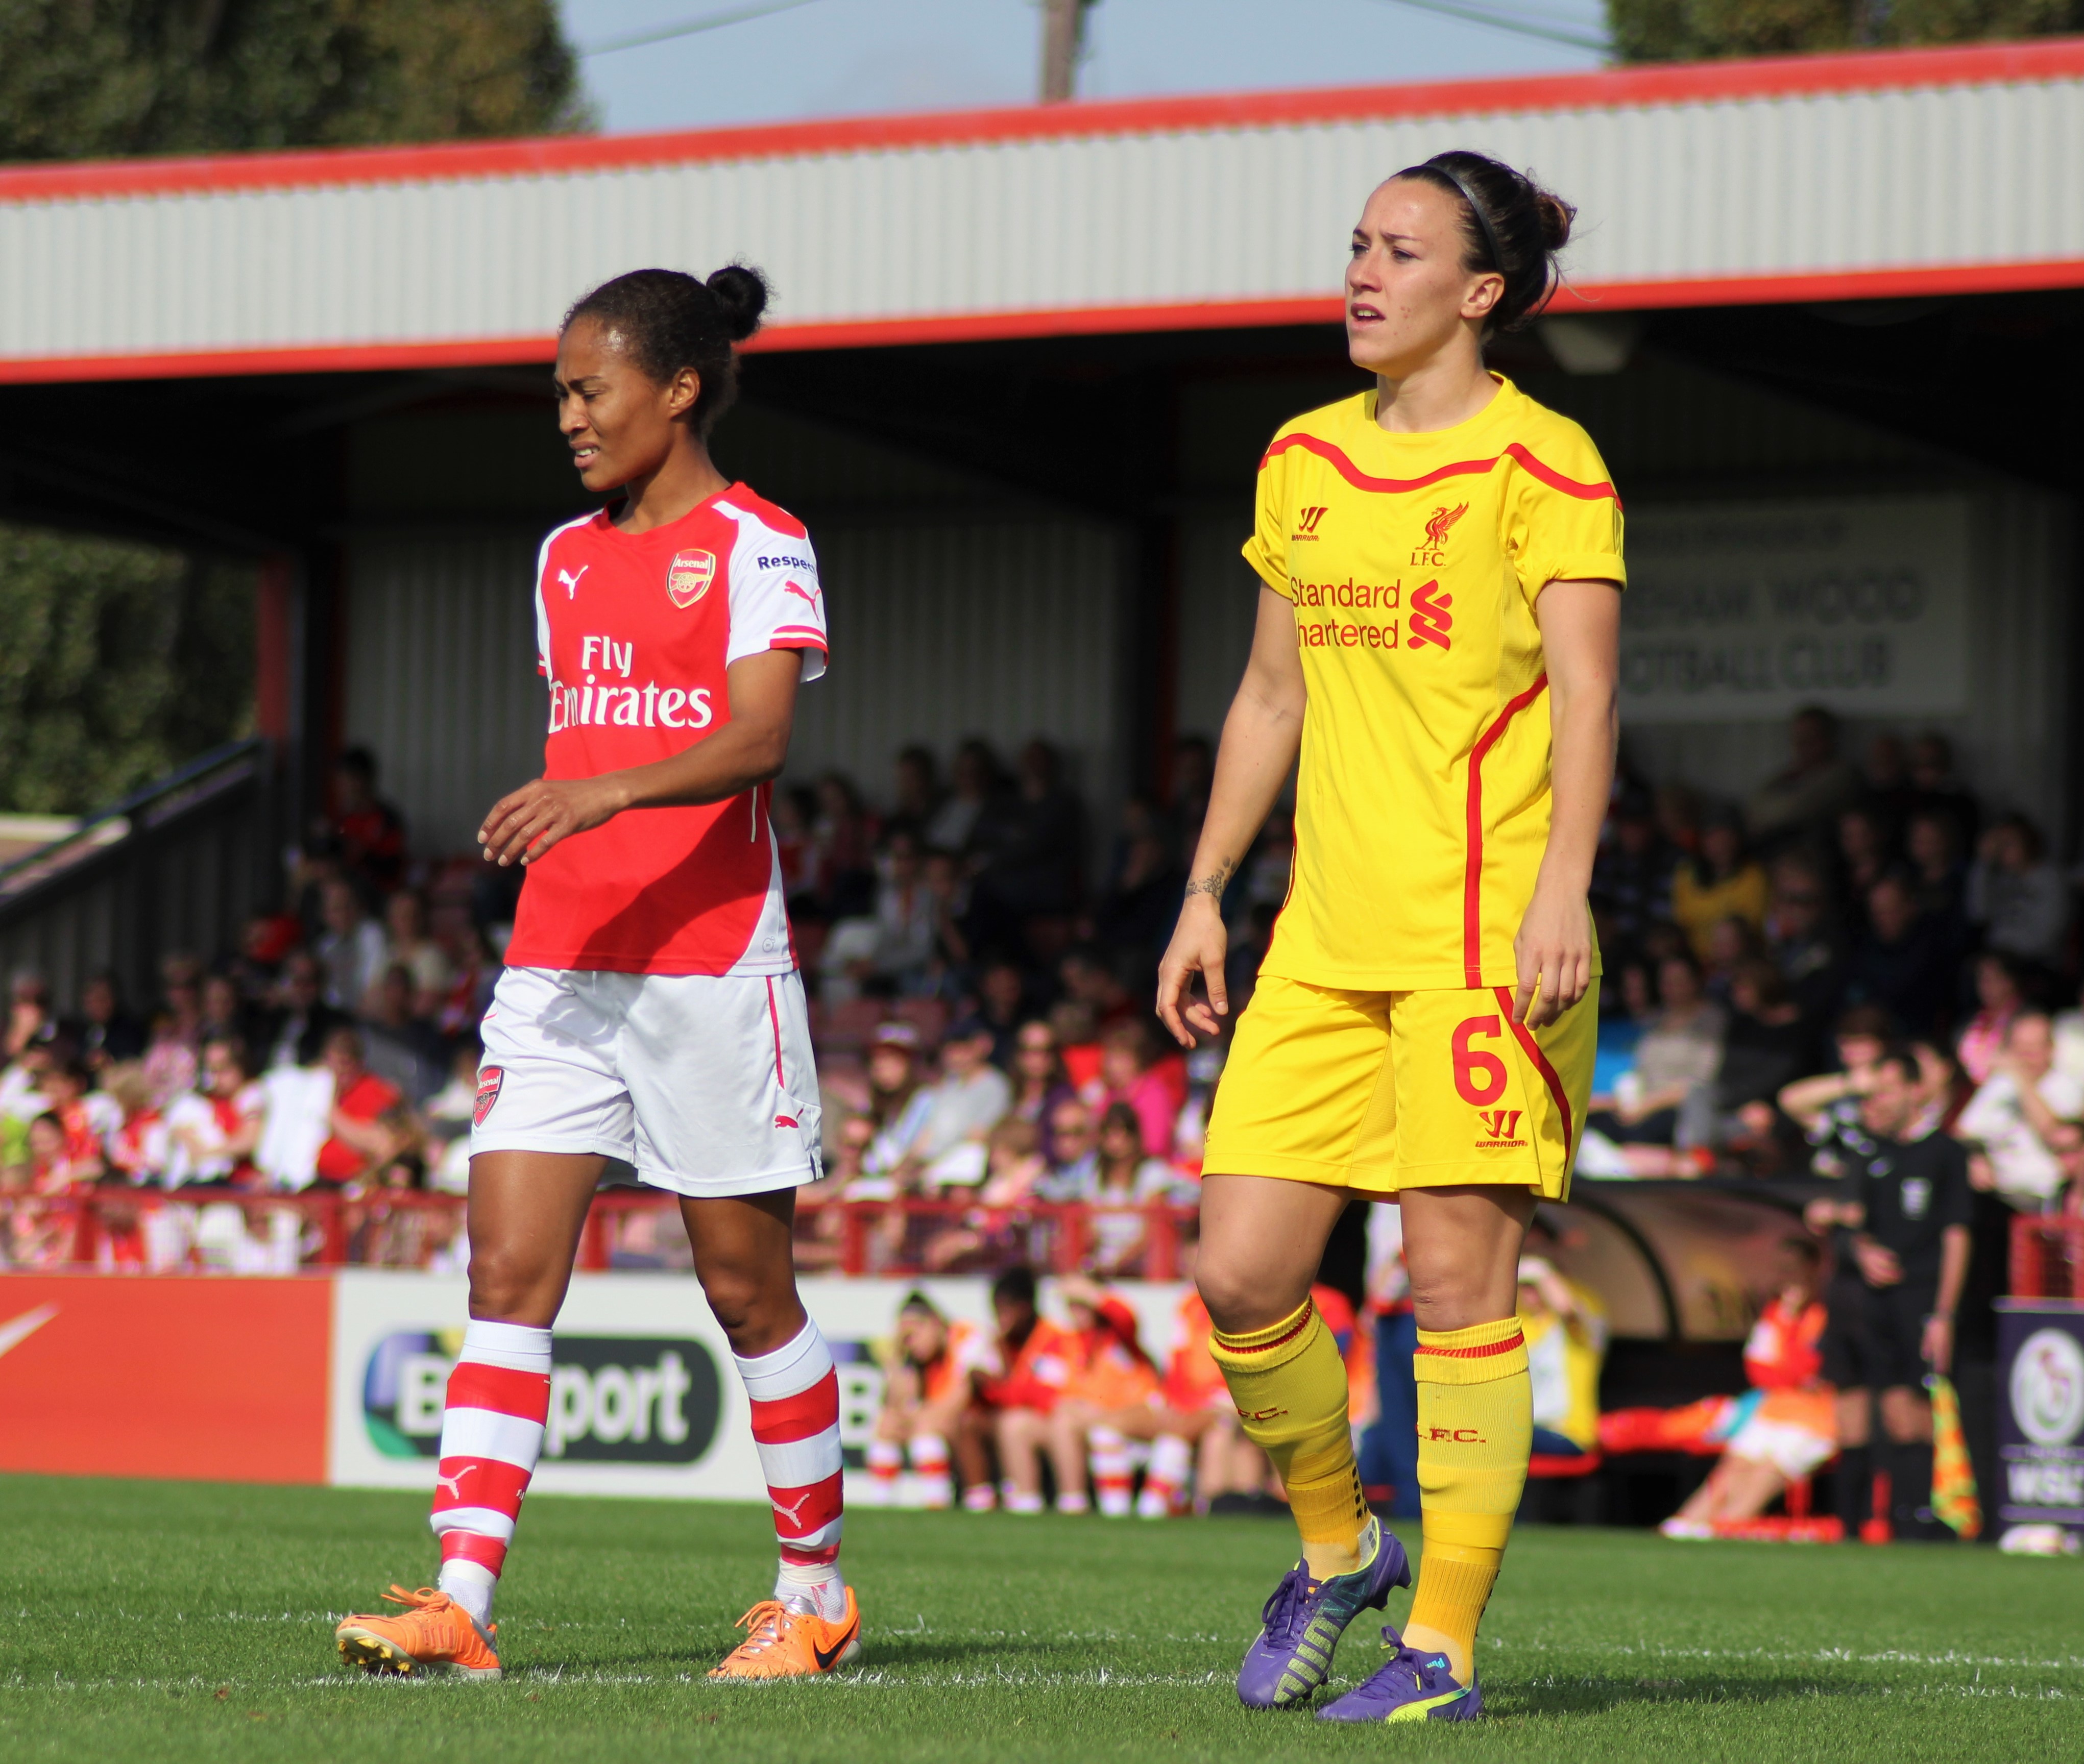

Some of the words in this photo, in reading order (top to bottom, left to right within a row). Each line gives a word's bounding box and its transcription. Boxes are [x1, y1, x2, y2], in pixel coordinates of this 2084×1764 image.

[674, 558, 709, 569] Arsenal
[757, 556, 817, 577] Respec
[1410, 552, 1446, 567] L.F.C.
[1291, 576, 1401, 609] Standard
[1297, 617, 1398, 649] hartered
[581, 636, 633, 678] Fly
[548, 674, 713, 734] Emirates
[1451, 1015, 1507, 1107] 6
[479, 1075, 499, 1089] Arsenal
[1475, 1140, 1525, 1148] WARRIOR
[549, 1350, 691, 1456] port
